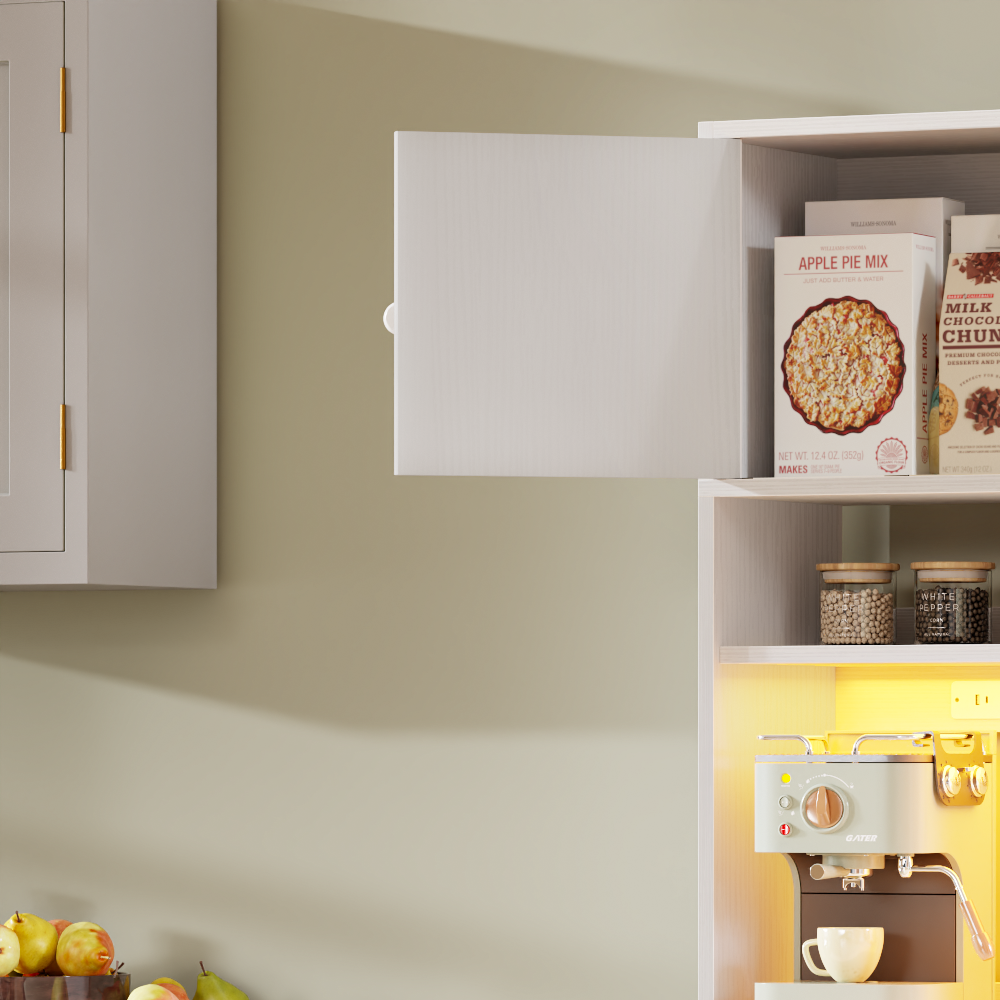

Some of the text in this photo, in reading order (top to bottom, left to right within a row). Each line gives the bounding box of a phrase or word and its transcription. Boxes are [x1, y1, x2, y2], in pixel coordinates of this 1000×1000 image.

[799, 254, 889, 271] APPLE PIE MIX
[945, 302, 993, 314] MILK
[778, 450, 864, 462] NET WT. 12.4 OZ. (352g)
[778, 465, 808, 474] MAKES
[921, 592, 955, 601] WHITE
[919, 603, 960, 612] PEPPER
[845, 834, 878, 842] GATER
